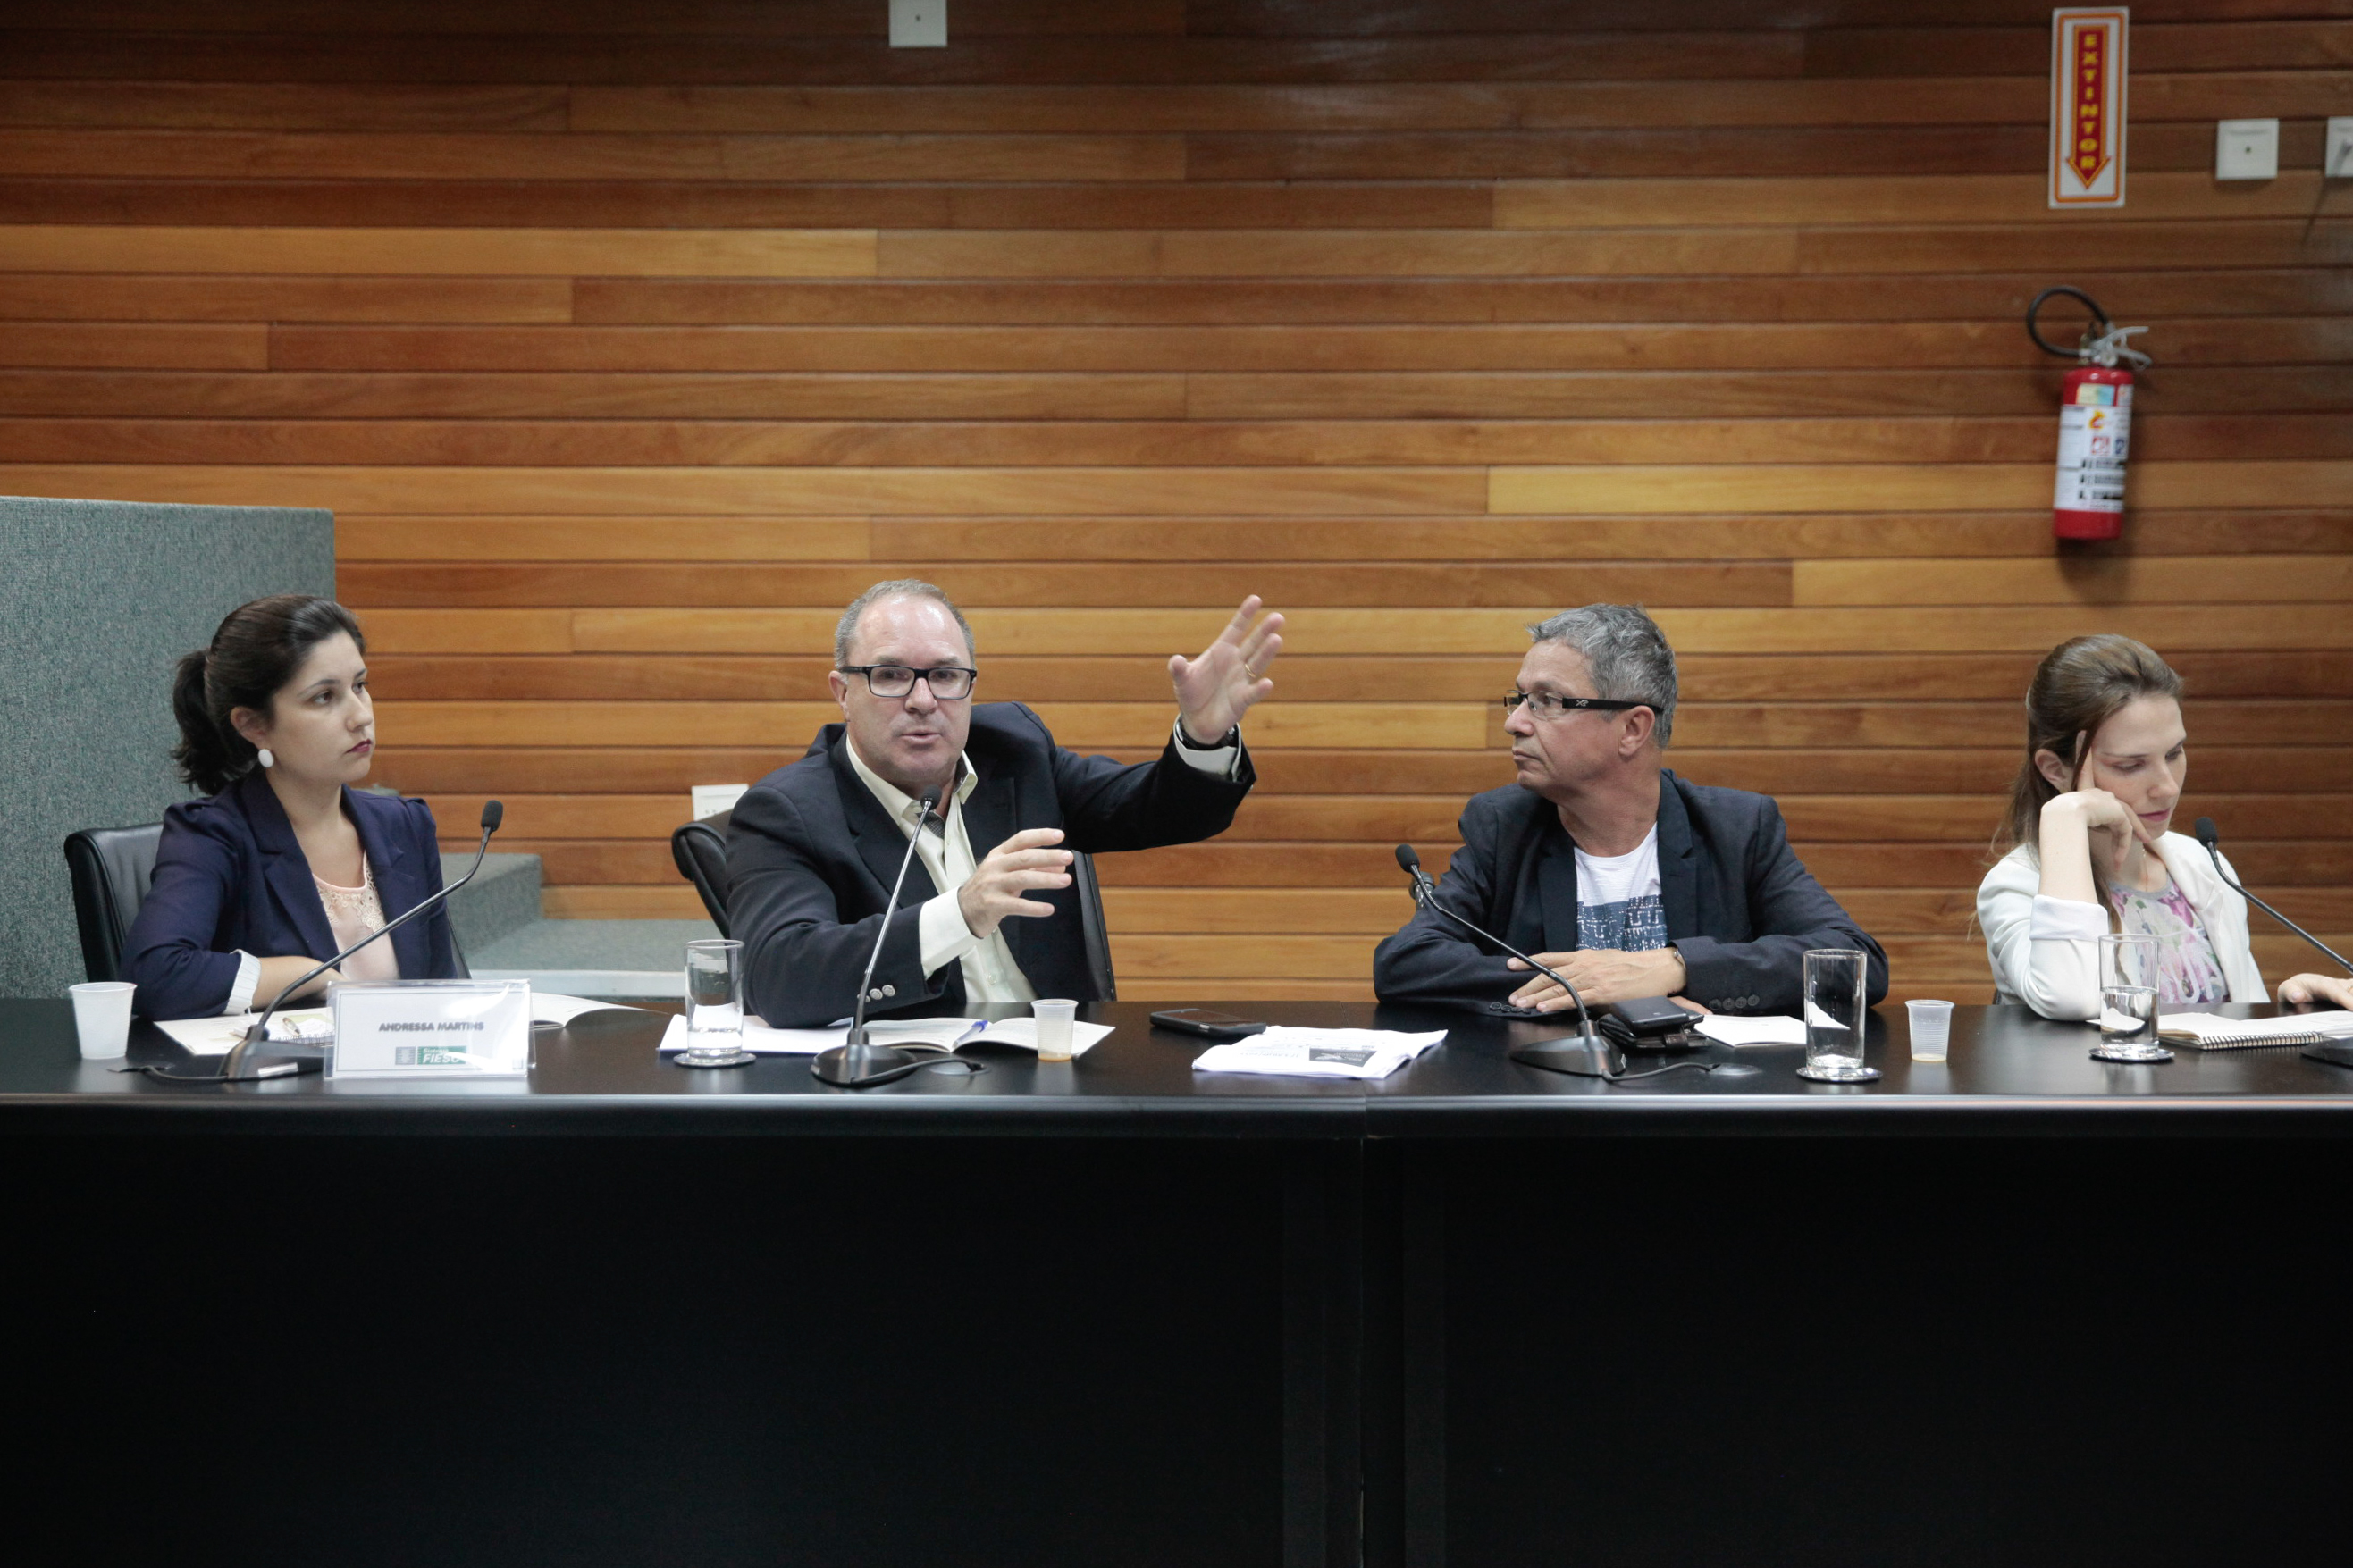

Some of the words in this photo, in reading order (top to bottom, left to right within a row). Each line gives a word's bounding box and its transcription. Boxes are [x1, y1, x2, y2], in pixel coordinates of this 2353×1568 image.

[2079, 33, 2098, 170] EXTINTOR
[379, 1022, 434, 1032] ANDRESSA
[437, 1021, 484, 1031] MARTINS
